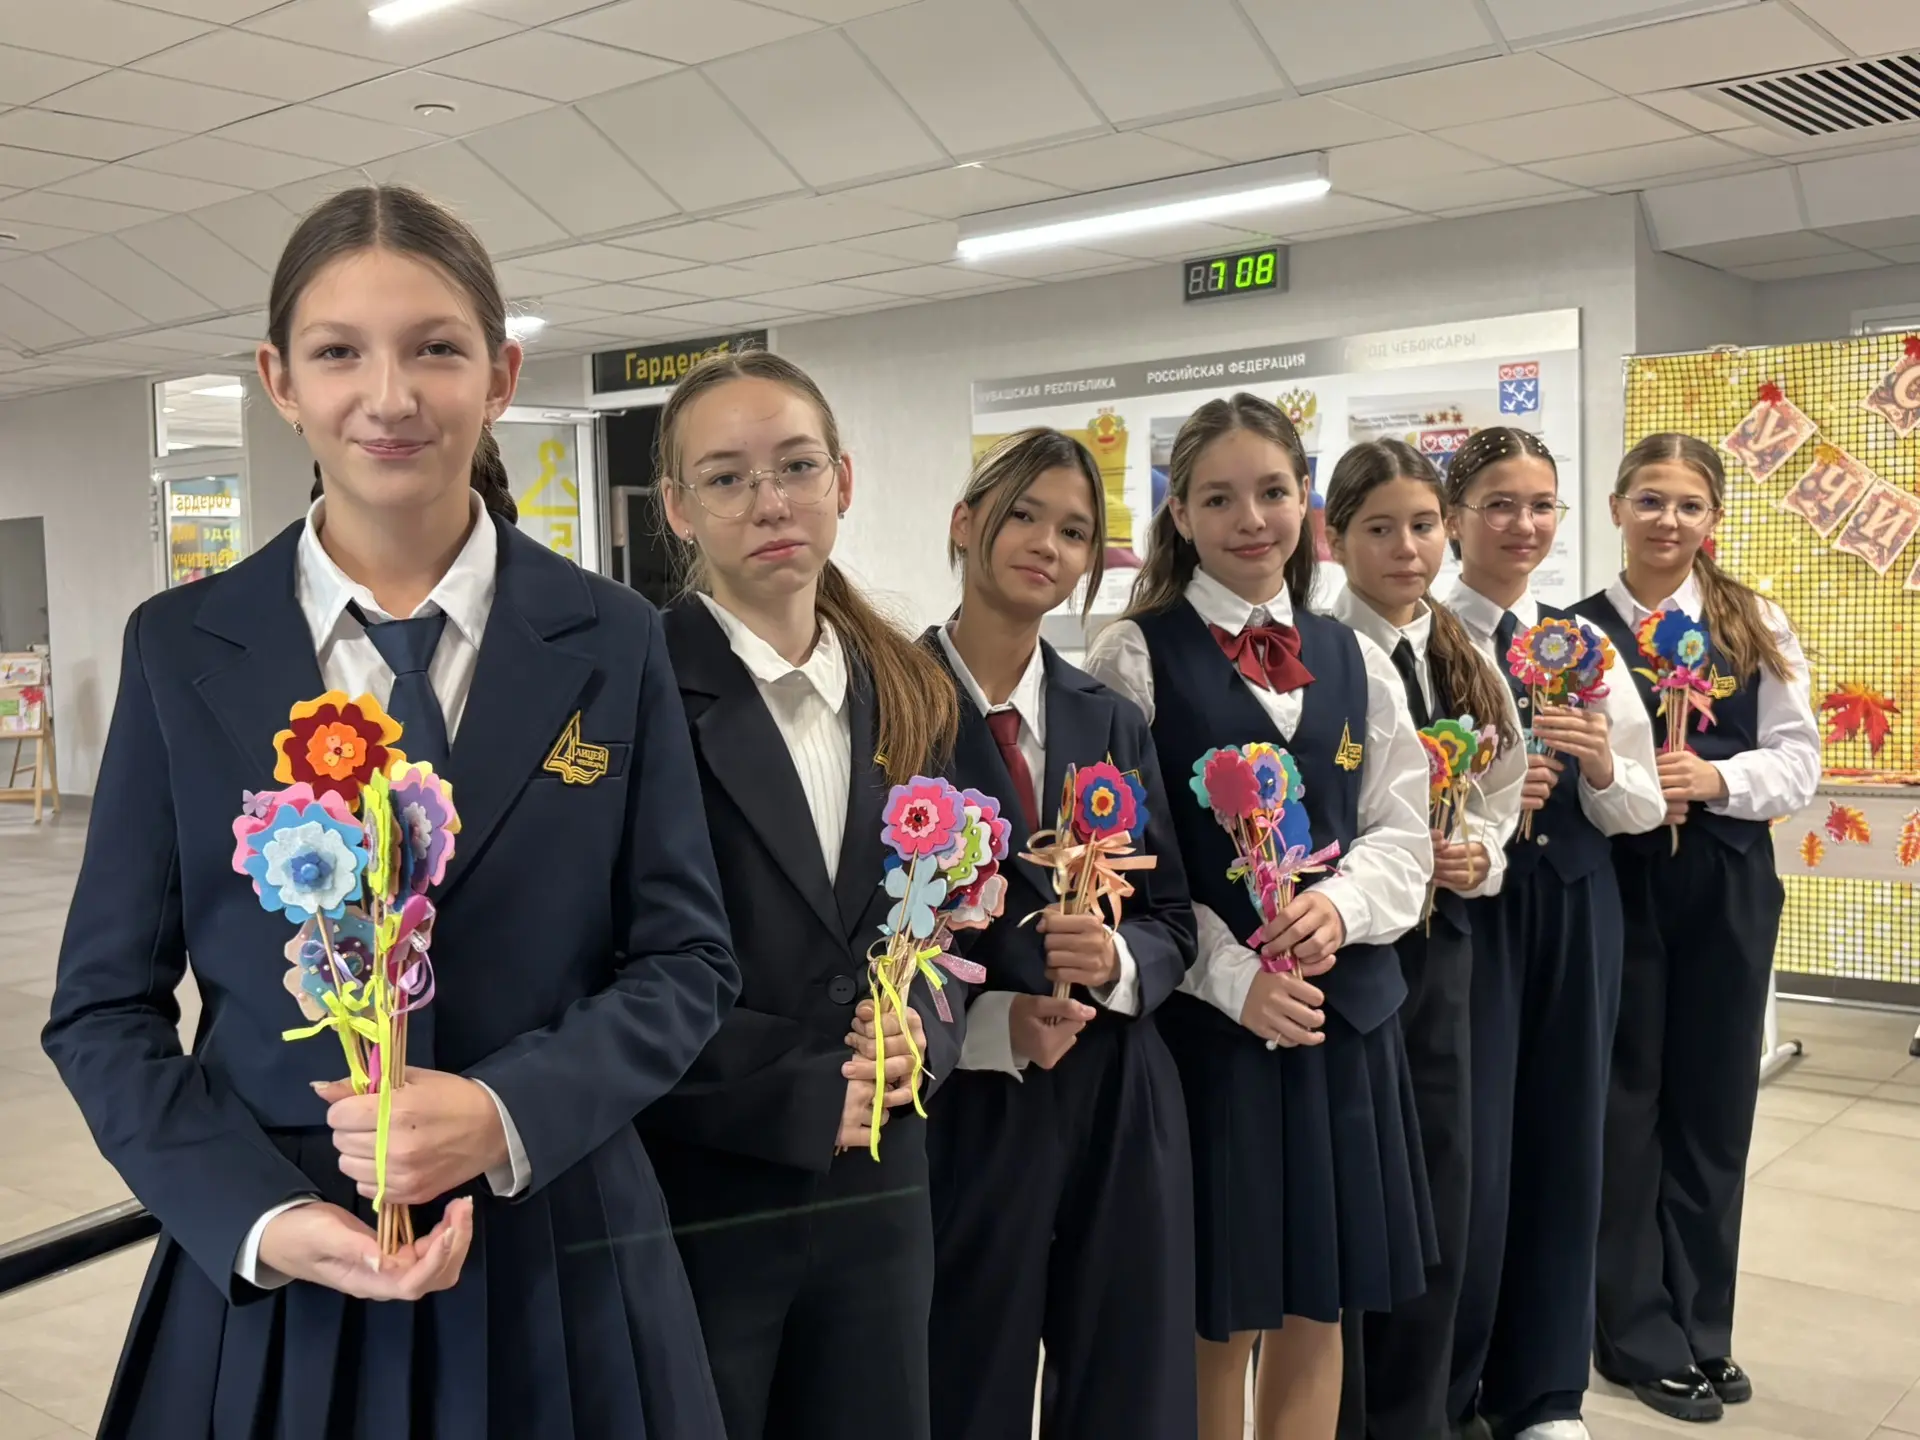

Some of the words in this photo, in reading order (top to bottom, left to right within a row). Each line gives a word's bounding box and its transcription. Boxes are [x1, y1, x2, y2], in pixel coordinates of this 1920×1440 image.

[1391, 332, 1476, 355] ЧЕБОКСАРЫ
[624, 340, 730, 385] Гардерб
[1146, 363, 1225, 385] РОССИЙСКАЯ
[1227, 352, 1306, 375] ФЕДЕРАЦИЯ
[976, 383, 1041, 403] УВАШСКАЯ
[1044, 376, 1117, 396] РЕСПУБЛИКА
